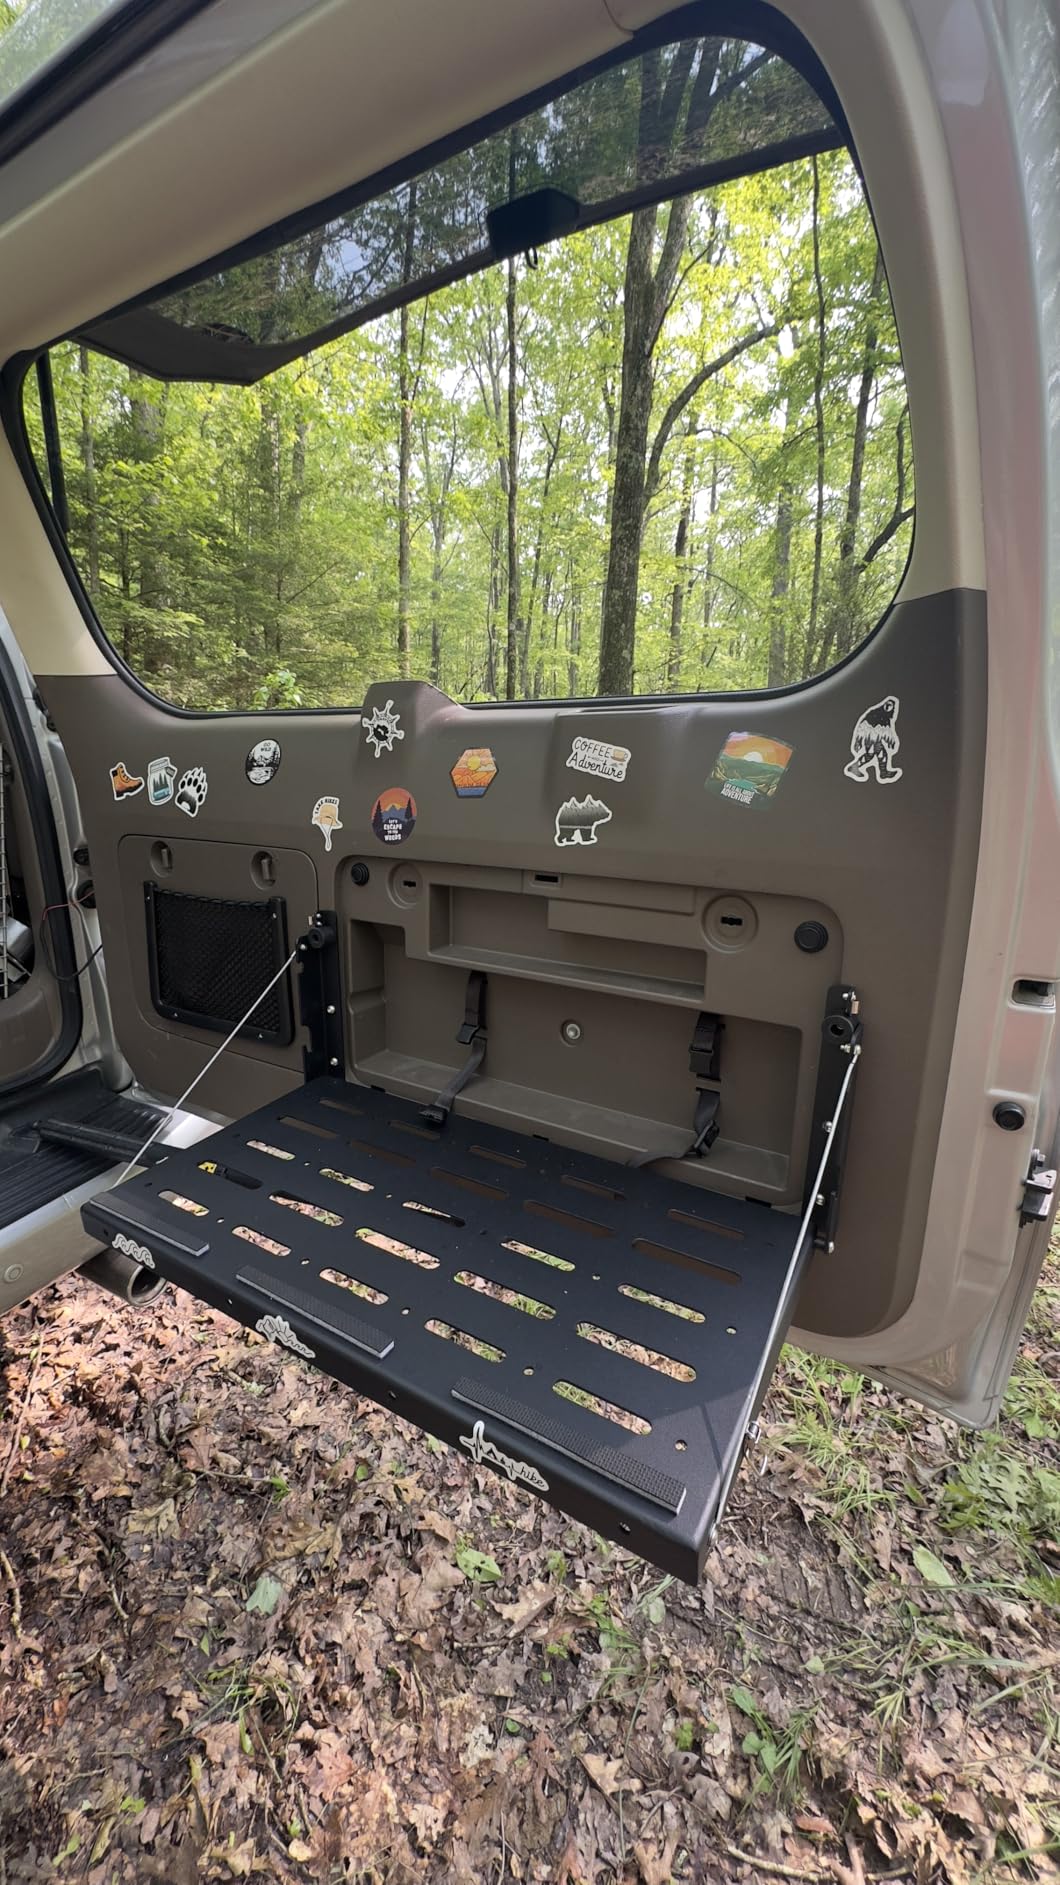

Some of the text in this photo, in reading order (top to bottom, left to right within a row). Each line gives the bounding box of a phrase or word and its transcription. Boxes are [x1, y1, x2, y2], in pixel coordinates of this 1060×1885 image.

[574, 739, 613, 759] COFFEE
[568, 751, 623, 779] Adventure
[720, 788, 752, 804] ADVENTURE
[519, 1466, 545, 1487] hike
